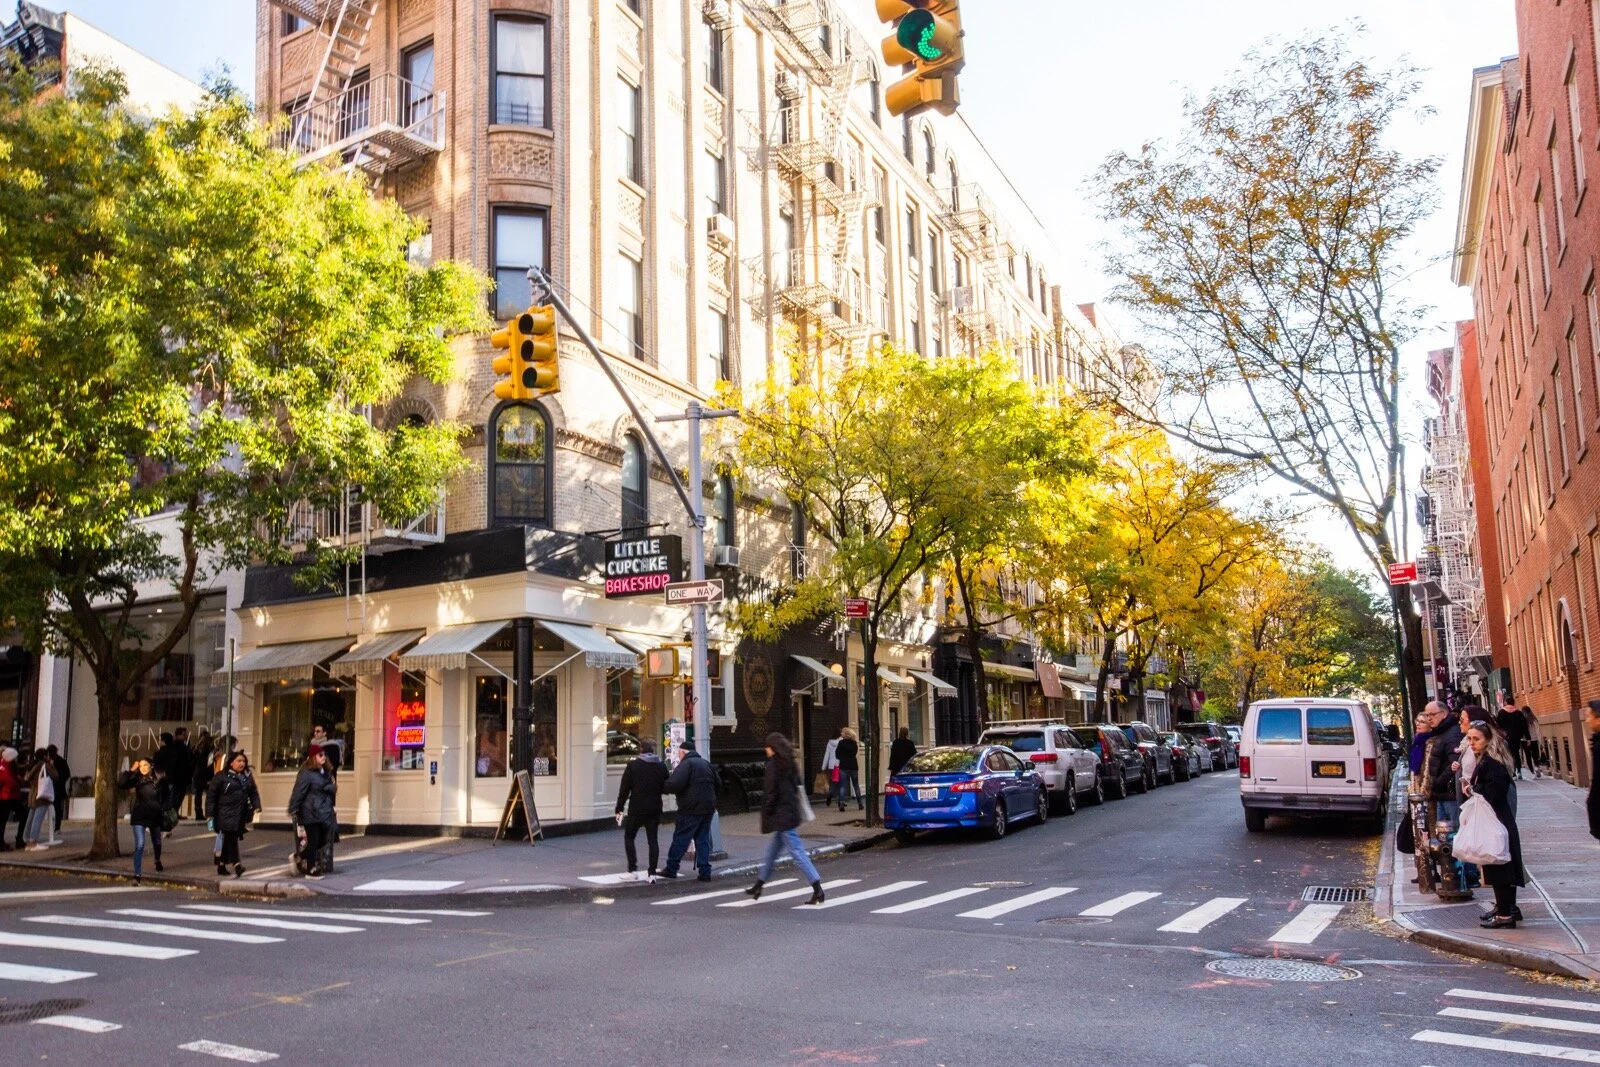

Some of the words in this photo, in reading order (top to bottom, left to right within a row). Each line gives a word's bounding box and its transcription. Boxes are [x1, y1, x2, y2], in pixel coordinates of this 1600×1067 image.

[615, 540, 660, 558] LITTLE
[608, 556, 668, 575] CUPCAKE
[606, 574, 670, 593] BAKESHOP
[670, 589, 687, 600] ONE
[696, 586, 715, 597] WAY
